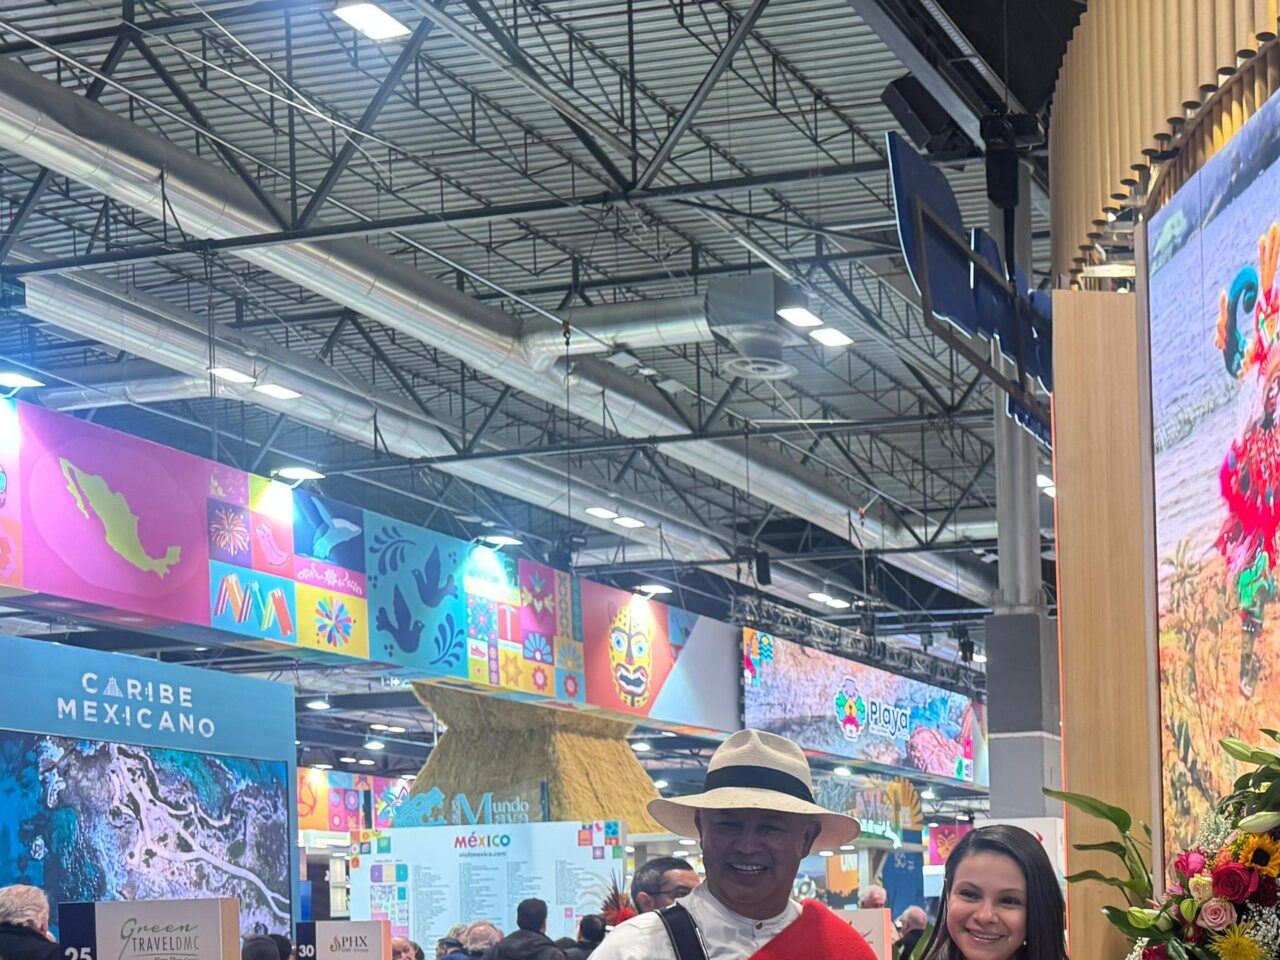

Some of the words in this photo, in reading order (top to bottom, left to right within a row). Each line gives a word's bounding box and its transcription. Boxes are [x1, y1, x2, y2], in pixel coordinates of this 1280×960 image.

[82, 672, 192, 707] CARIBE
[57, 697, 215, 738] MEXICANO
[871, 701, 908, 736] Playa
[299, 944, 314, 957] 30
[342, 936, 368, 947] PHX
